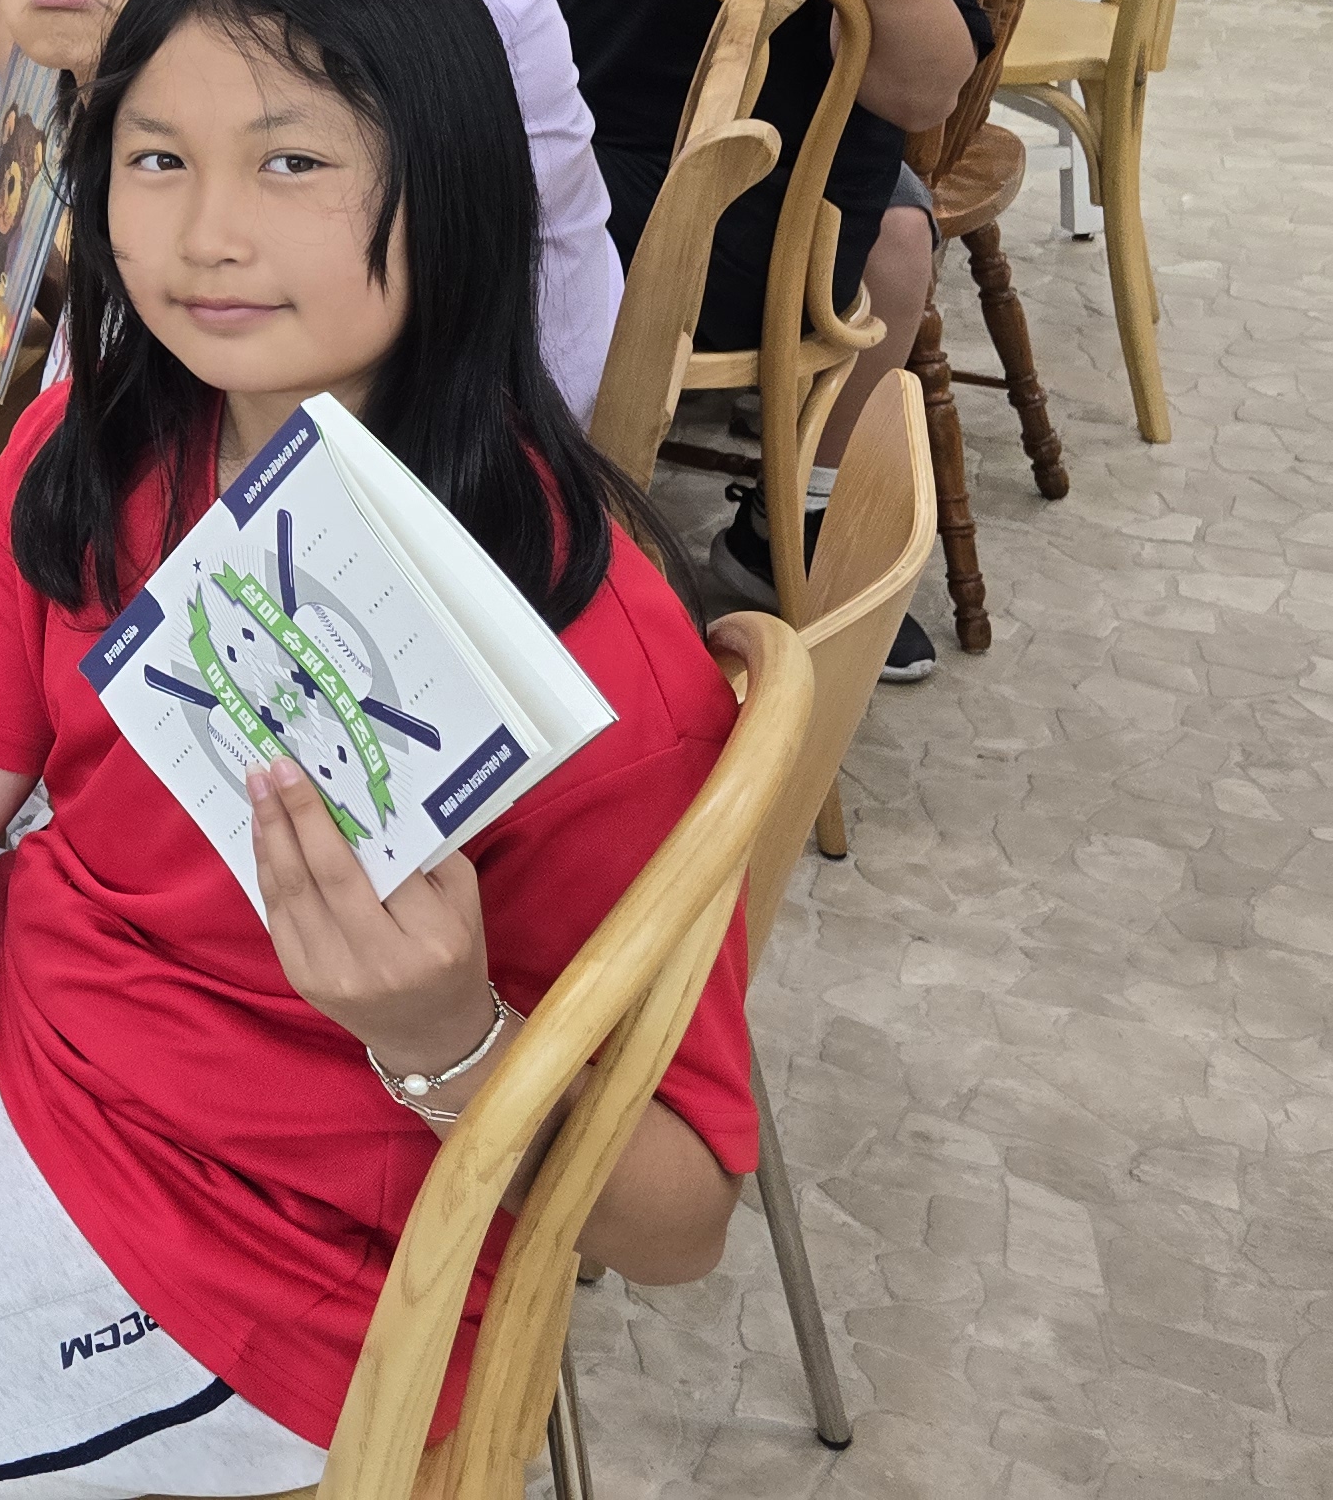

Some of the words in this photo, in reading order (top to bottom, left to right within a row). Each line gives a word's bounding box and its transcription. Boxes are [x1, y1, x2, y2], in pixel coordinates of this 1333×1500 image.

[206, 661, 259, 734] 마지막
[240, 583, 281, 627] 삼미
[282, 629, 383, 774] 슈퍼스타즈의
